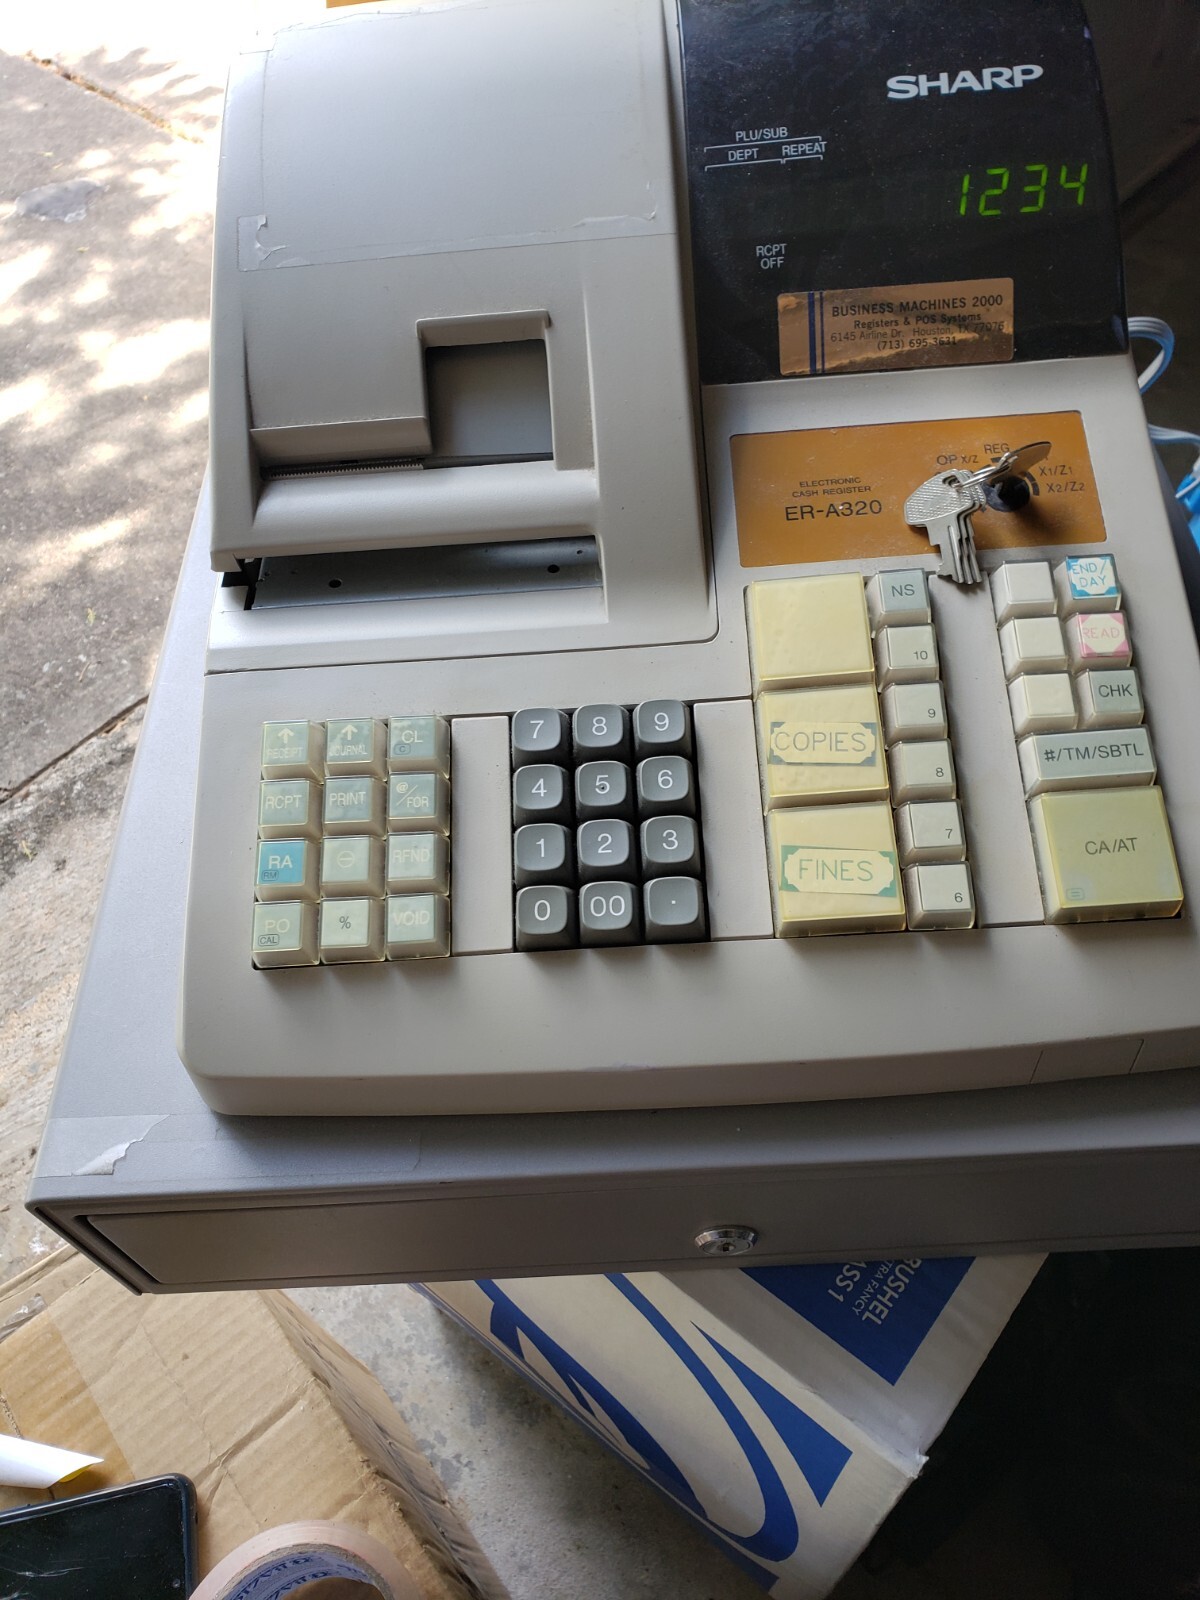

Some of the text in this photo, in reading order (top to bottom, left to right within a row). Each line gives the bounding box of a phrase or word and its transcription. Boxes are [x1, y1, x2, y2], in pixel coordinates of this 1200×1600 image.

[886, 64, 1044, 99] SHARP
[735, 126, 788, 142] PLU/SUB
[728, 141, 827, 162] DEPT REPEAT
[959, 163, 1088, 216] 1234
[755, 243, 787, 257] RCPT
[760, 257, 785, 270] OFF
[831, 294, 1004, 317] BUSINESS MACHINES 2000
[853, 312, 982, 331] Registers & POS Systems
[830, 331, 856, 343] 6145
[859, 329, 888, 341] Airline
[877, 339, 905, 351] (713)
[984, 442, 1010, 455] REG
[936, 454, 958, 466] OP
[799, 476, 862, 488] ELECTRONIC
[1045, 480, 1086, 494] X2/Z2
[792, 485, 872, 499] CASH REGISTER
[785, 500, 883, 522] ER-A320
[1079, 575, 1106, 588] DAY
[891, 583, 916, 598] NS
[1082, 626, 1120, 639] READ
[913, 649, 929, 662] 10
[1098, 683, 1134, 699] CHK
[927, 708, 936, 719] 9
[529, 719, 545, 739] 7
[591, 716, 608, 736] 8
[653, 712, 670, 732] 9
[401, 730, 423, 744] CL
[773, 731, 867, 752] COPIES
[329, 744, 368, 757] JOURNAL
[1044, 743, 1145, 762] #/TM/SBTL
[657, 769, 673, 789] 6
[935, 767, 945, 778] 8
[531, 778, 548, 797] 4
[595, 774, 611, 794] 5
[265, 794, 302, 809] RCPT
[329, 791, 367, 806] PRINT
[662, 829, 679, 850] 3
[945, 828, 953, 839] 7
[535, 838, 546, 858] 1
[597, 833, 612, 854] 2
[1084, 837, 1138, 856] CA/AT
[268, 854, 293, 869] RA
[391, 849, 431, 864] RFND
[798, 858, 874, 882] FINES
[590, 895, 625, 917] 00
[954, 892, 963, 904] 6
[392, 910, 431, 926] VOID
[534, 899, 551, 921] 0
[264, 918, 291, 934] PO
[339, 915, 352, 930] %
[259, 935, 278, 945] CAL
[852, 1259, 896, 1316] TRA FANCY
